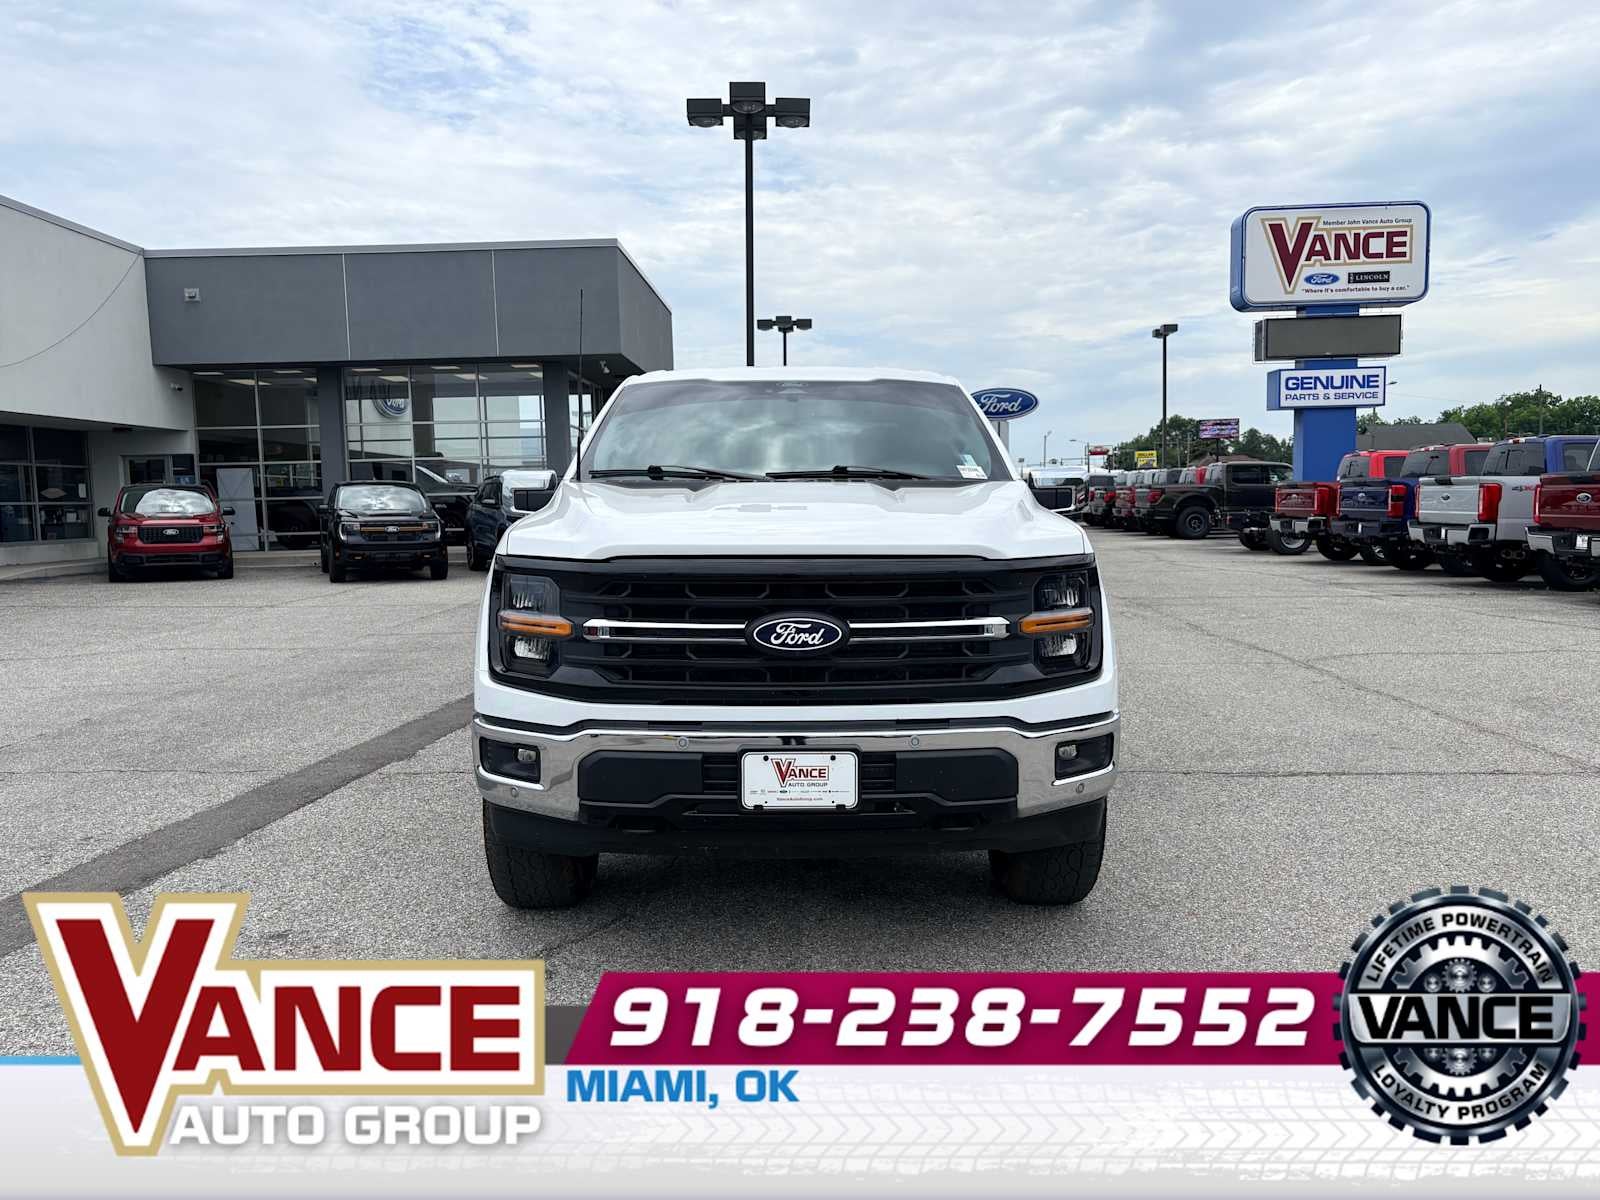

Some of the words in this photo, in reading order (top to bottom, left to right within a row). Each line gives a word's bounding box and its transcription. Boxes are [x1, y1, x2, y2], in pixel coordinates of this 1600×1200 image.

[1311, 274, 1334, 284] Ford
[1285, 374, 1380, 391] GENUINE
[980, 393, 1022, 412] Ford
[1285, 392, 1319, 401] PARTS
[1322, 392, 1330, 400] &
[1334, 391, 1379, 400] SERVICE
[770, 622, 825, 645] Ford
[772, 760, 827, 786] VANCE
